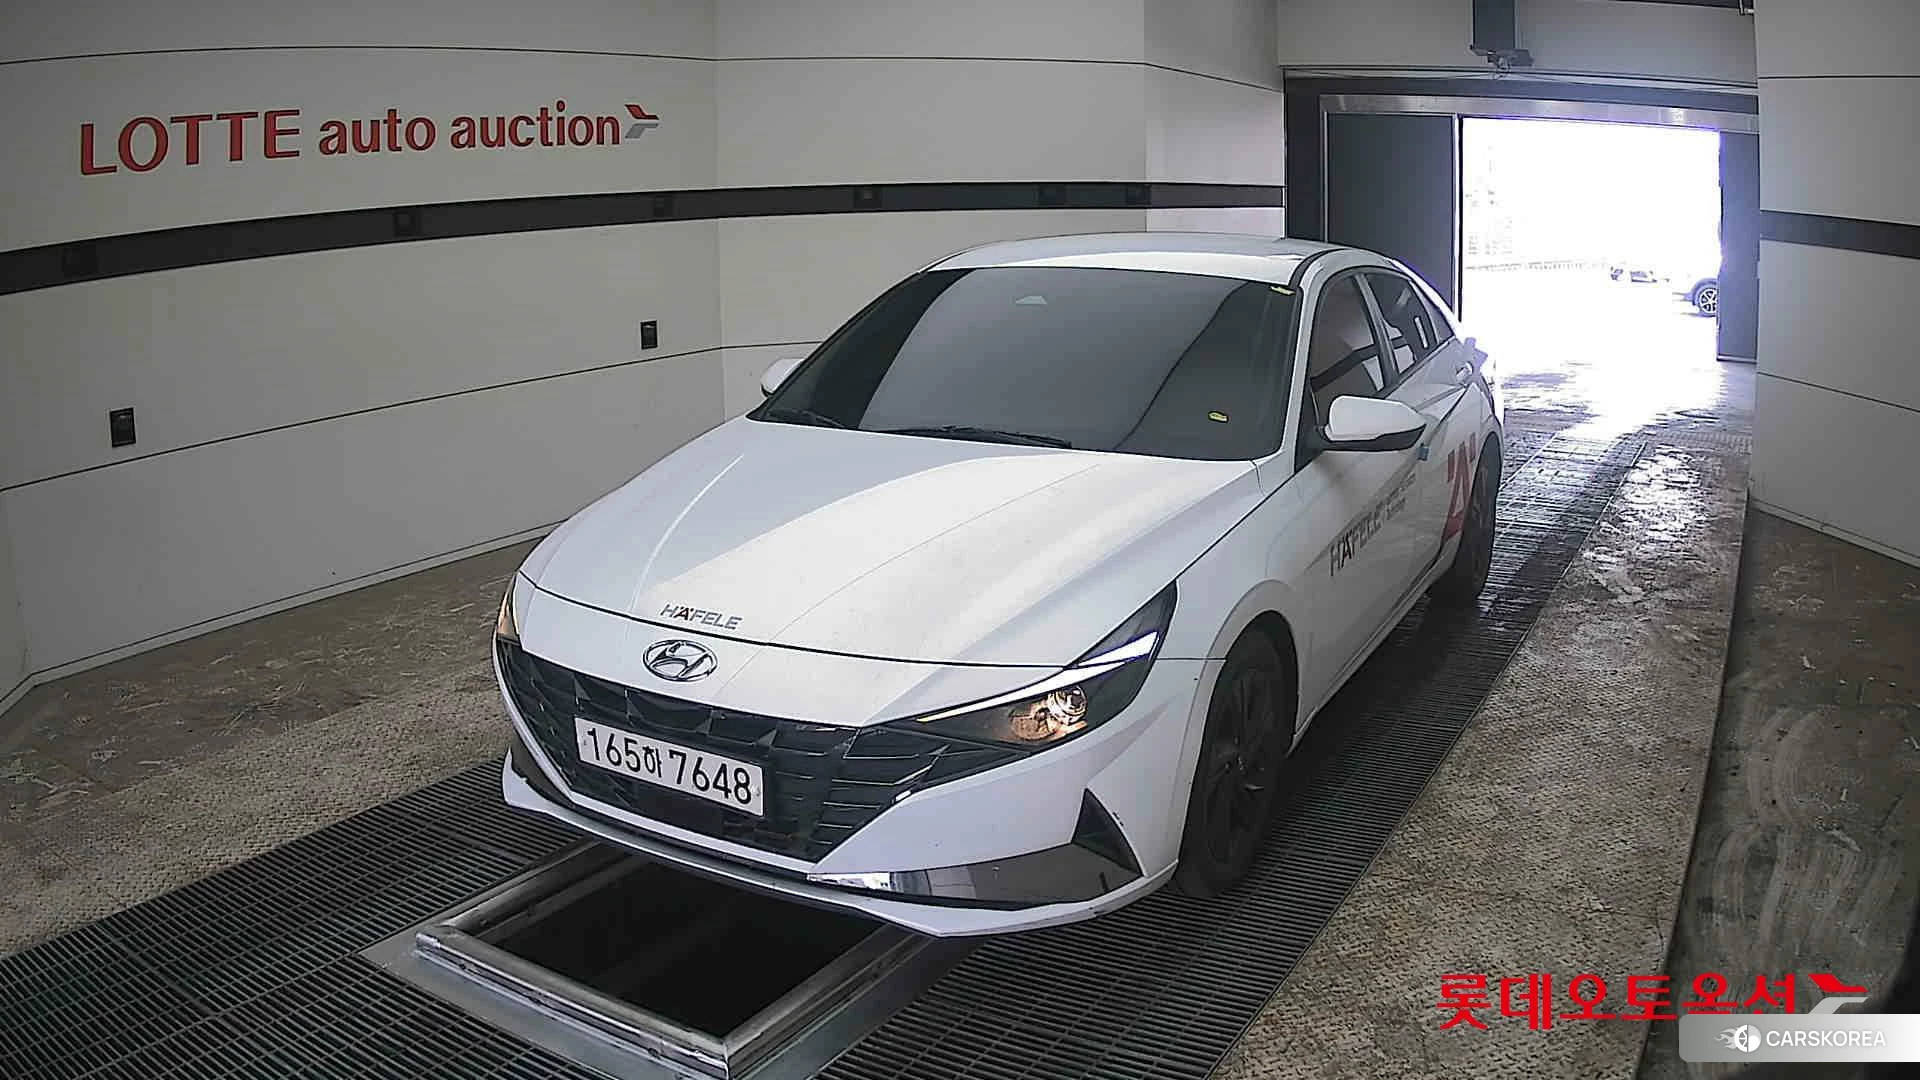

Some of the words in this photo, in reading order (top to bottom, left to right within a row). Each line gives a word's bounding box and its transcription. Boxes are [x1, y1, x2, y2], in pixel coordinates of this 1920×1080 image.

[80, 108, 301, 176] LOTTE
[318, 107, 437, 155] auto
[450, 100, 621, 150] auction
[659, 604, 743, 631] HÄFELE
[586, 727, 663, 779] 165하
[668, 749, 752, 805] 7648
